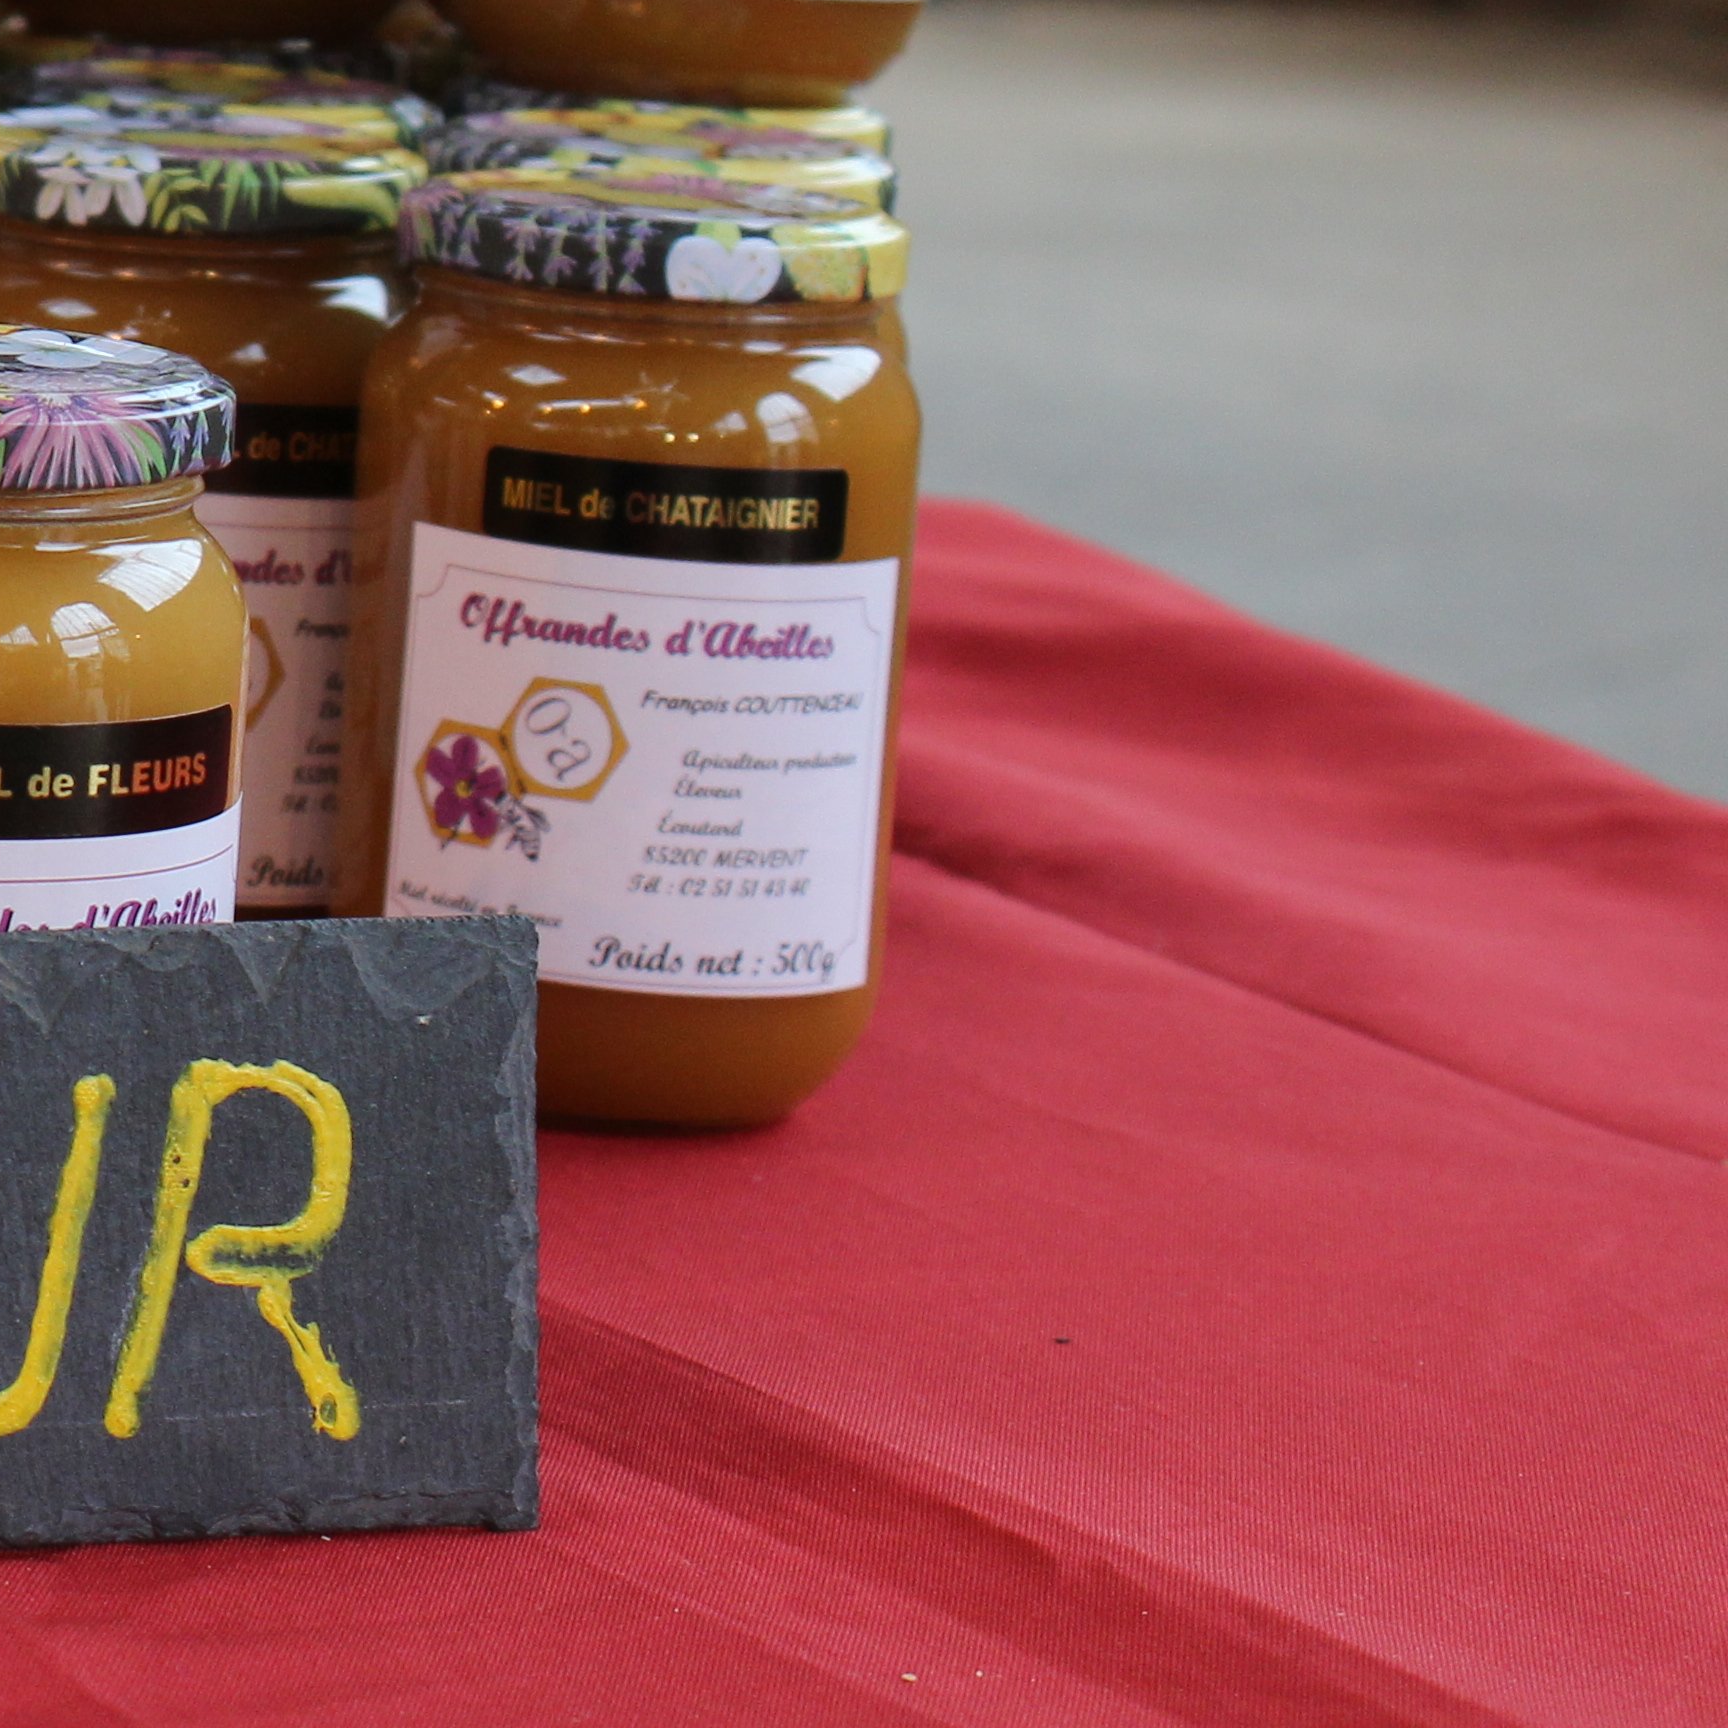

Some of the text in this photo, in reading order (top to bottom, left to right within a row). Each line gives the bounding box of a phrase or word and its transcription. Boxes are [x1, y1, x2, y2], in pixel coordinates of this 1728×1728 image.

[502, 475, 820, 532] MIEL de CHATAIGNIER
[459, 589, 835, 661] Offrandes d'Abeilles
[641, 688, 728, 715] François
[27, 765, 76, 800] de
[87, 751, 207, 798] FLEURS
[713, 848, 809, 869] MERVENT
[588, 934, 684, 975] Poids
[696, 949, 744, 977] net
[771, 941, 837, 984] 500g
